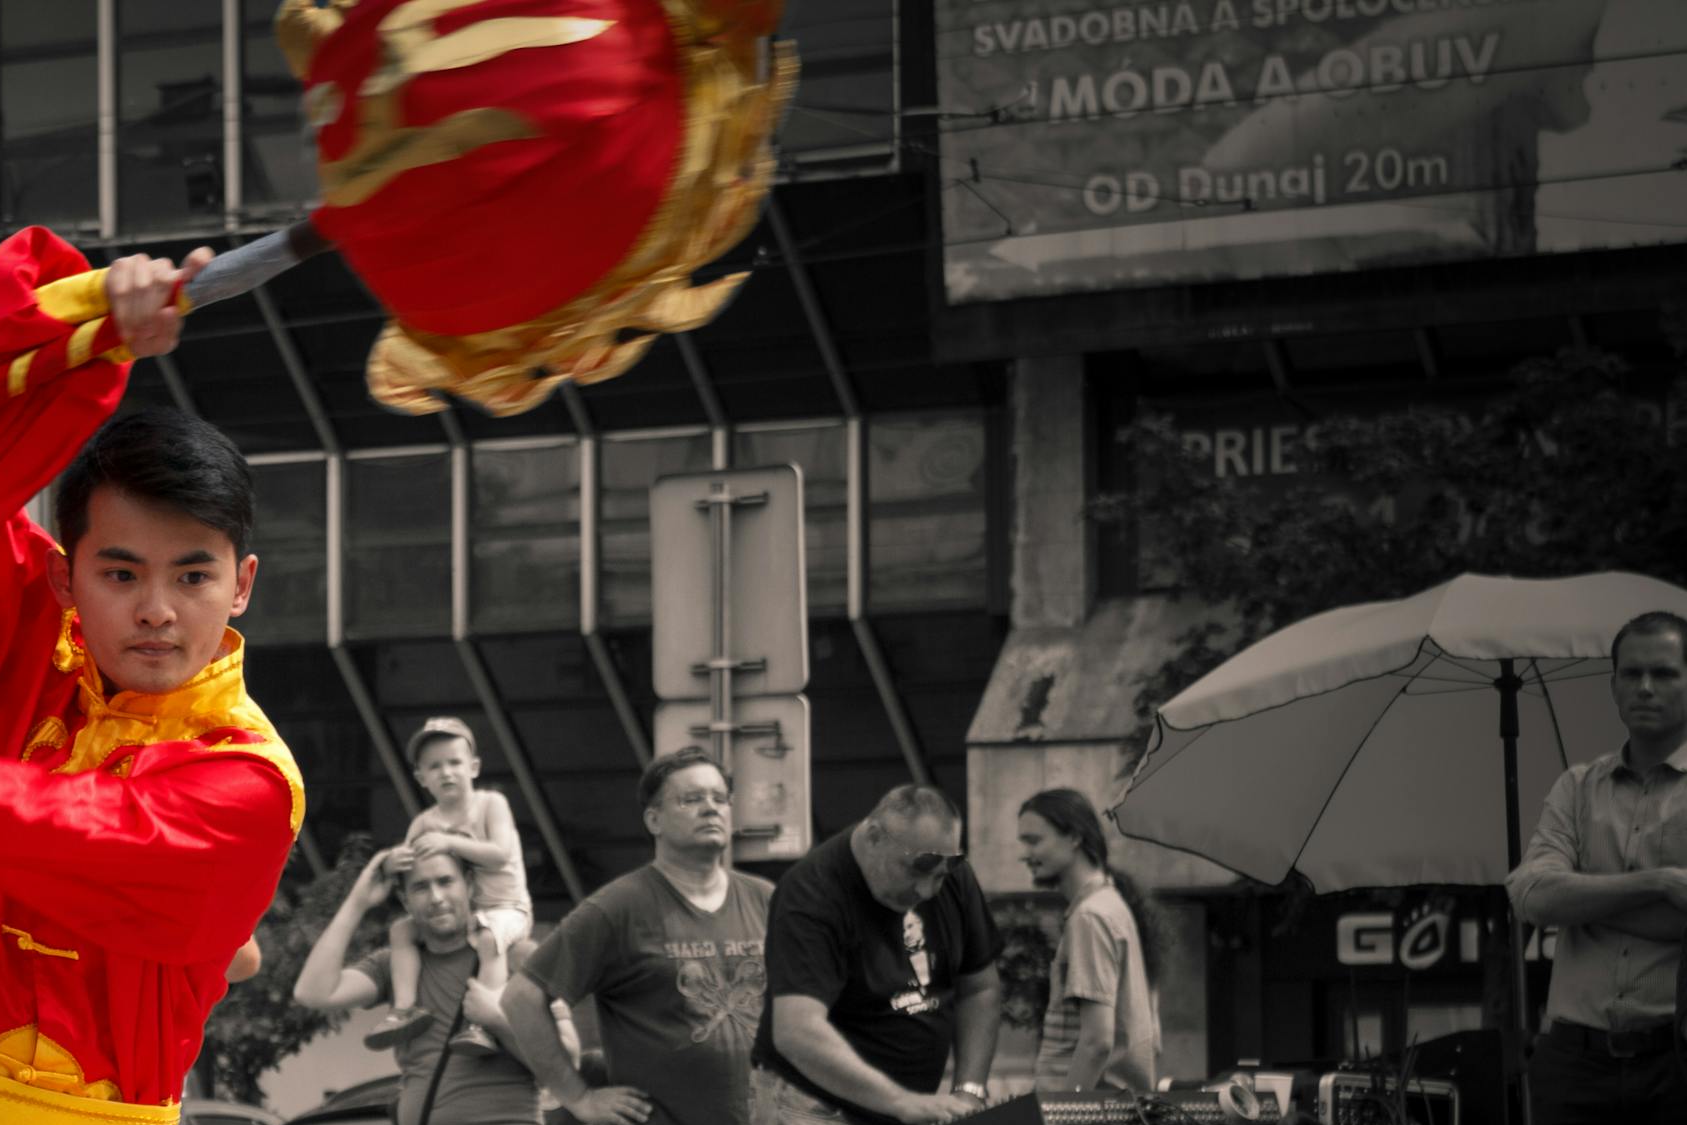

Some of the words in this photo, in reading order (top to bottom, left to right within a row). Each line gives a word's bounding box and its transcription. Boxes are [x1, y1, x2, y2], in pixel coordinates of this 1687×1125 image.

[973, 3, 1199, 57] SVADOBNA
[1212, 0, 1241, 31] A
[1050, 55, 1236, 124] MÓDA
[1254, 55, 1300, 105] A
[1314, 33, 1502, 99] OBUV
[1083, 169, 1160, 216] OD
[1179, 153, 1326, 206] Dunaj
[1343, 148, 1449, 194] 20m
